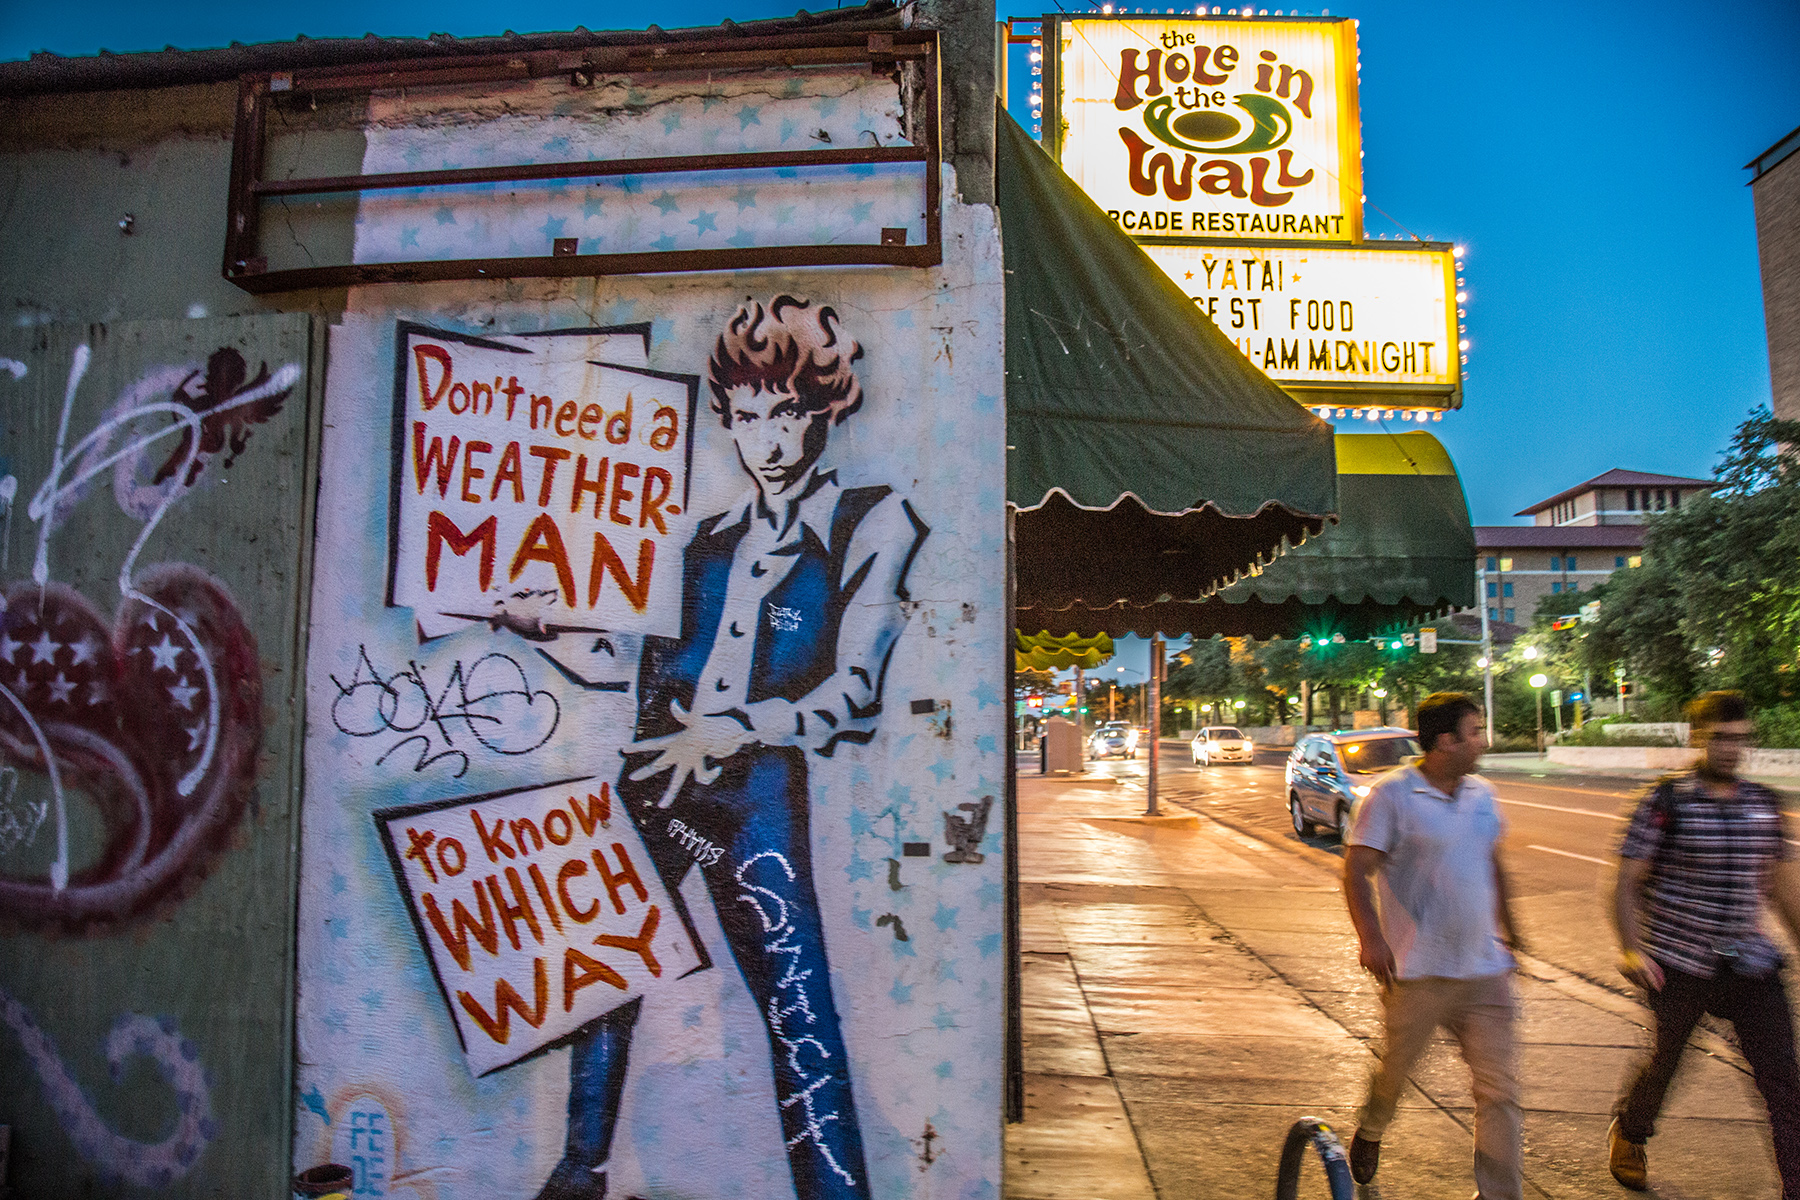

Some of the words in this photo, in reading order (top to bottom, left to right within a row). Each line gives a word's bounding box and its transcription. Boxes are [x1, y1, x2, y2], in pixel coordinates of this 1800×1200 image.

[1160, 30, 1196, 49] the
[1175, 86, 1226, 110] the
[1255, 50, 1314, 118] in
[1192, 211, 1344, 234] RESTAURANT
[1202, 259, 1283, 291] YATAI
[1191, 297, 1261, 330] EST
[1290, 299, 1353, 332] FOOD
[412, 344, 525, 421] Don't
[529, 391, 634, 445] need
[645, 401, 680, 452] a
[425, 510, 657, 615] MAN
[405, 826, 467, 884] to
[470, 782, 612, 864] know
[421, 842, 649, 973] WHICH
[456, 904, 662, 1045] WAY
